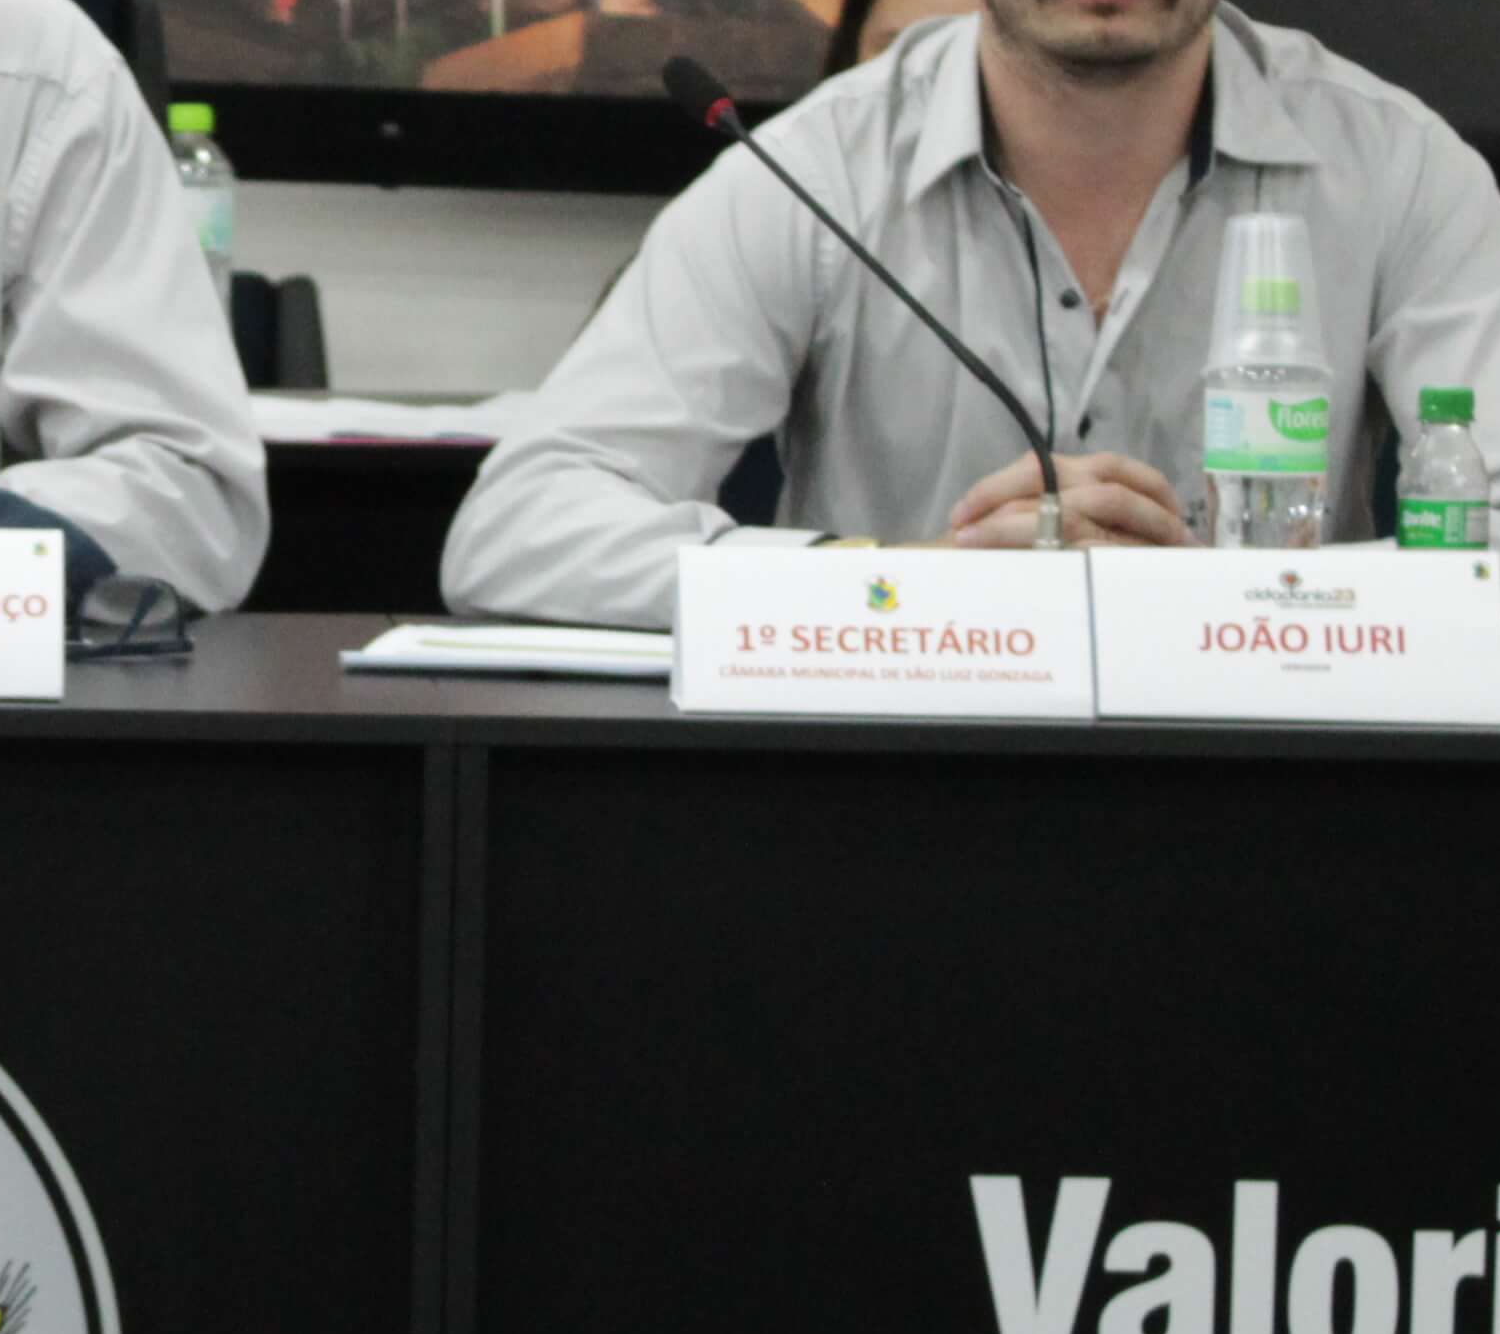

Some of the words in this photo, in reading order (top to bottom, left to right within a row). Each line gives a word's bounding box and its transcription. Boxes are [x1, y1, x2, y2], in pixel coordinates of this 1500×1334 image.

[736, 624, 777, 652] 1º
[790, 621, 1036, 657] SECRETÁRIO
[1198, 615, 1310, 655] JOÃO
[1323, 624, 1407, 655] IURI
